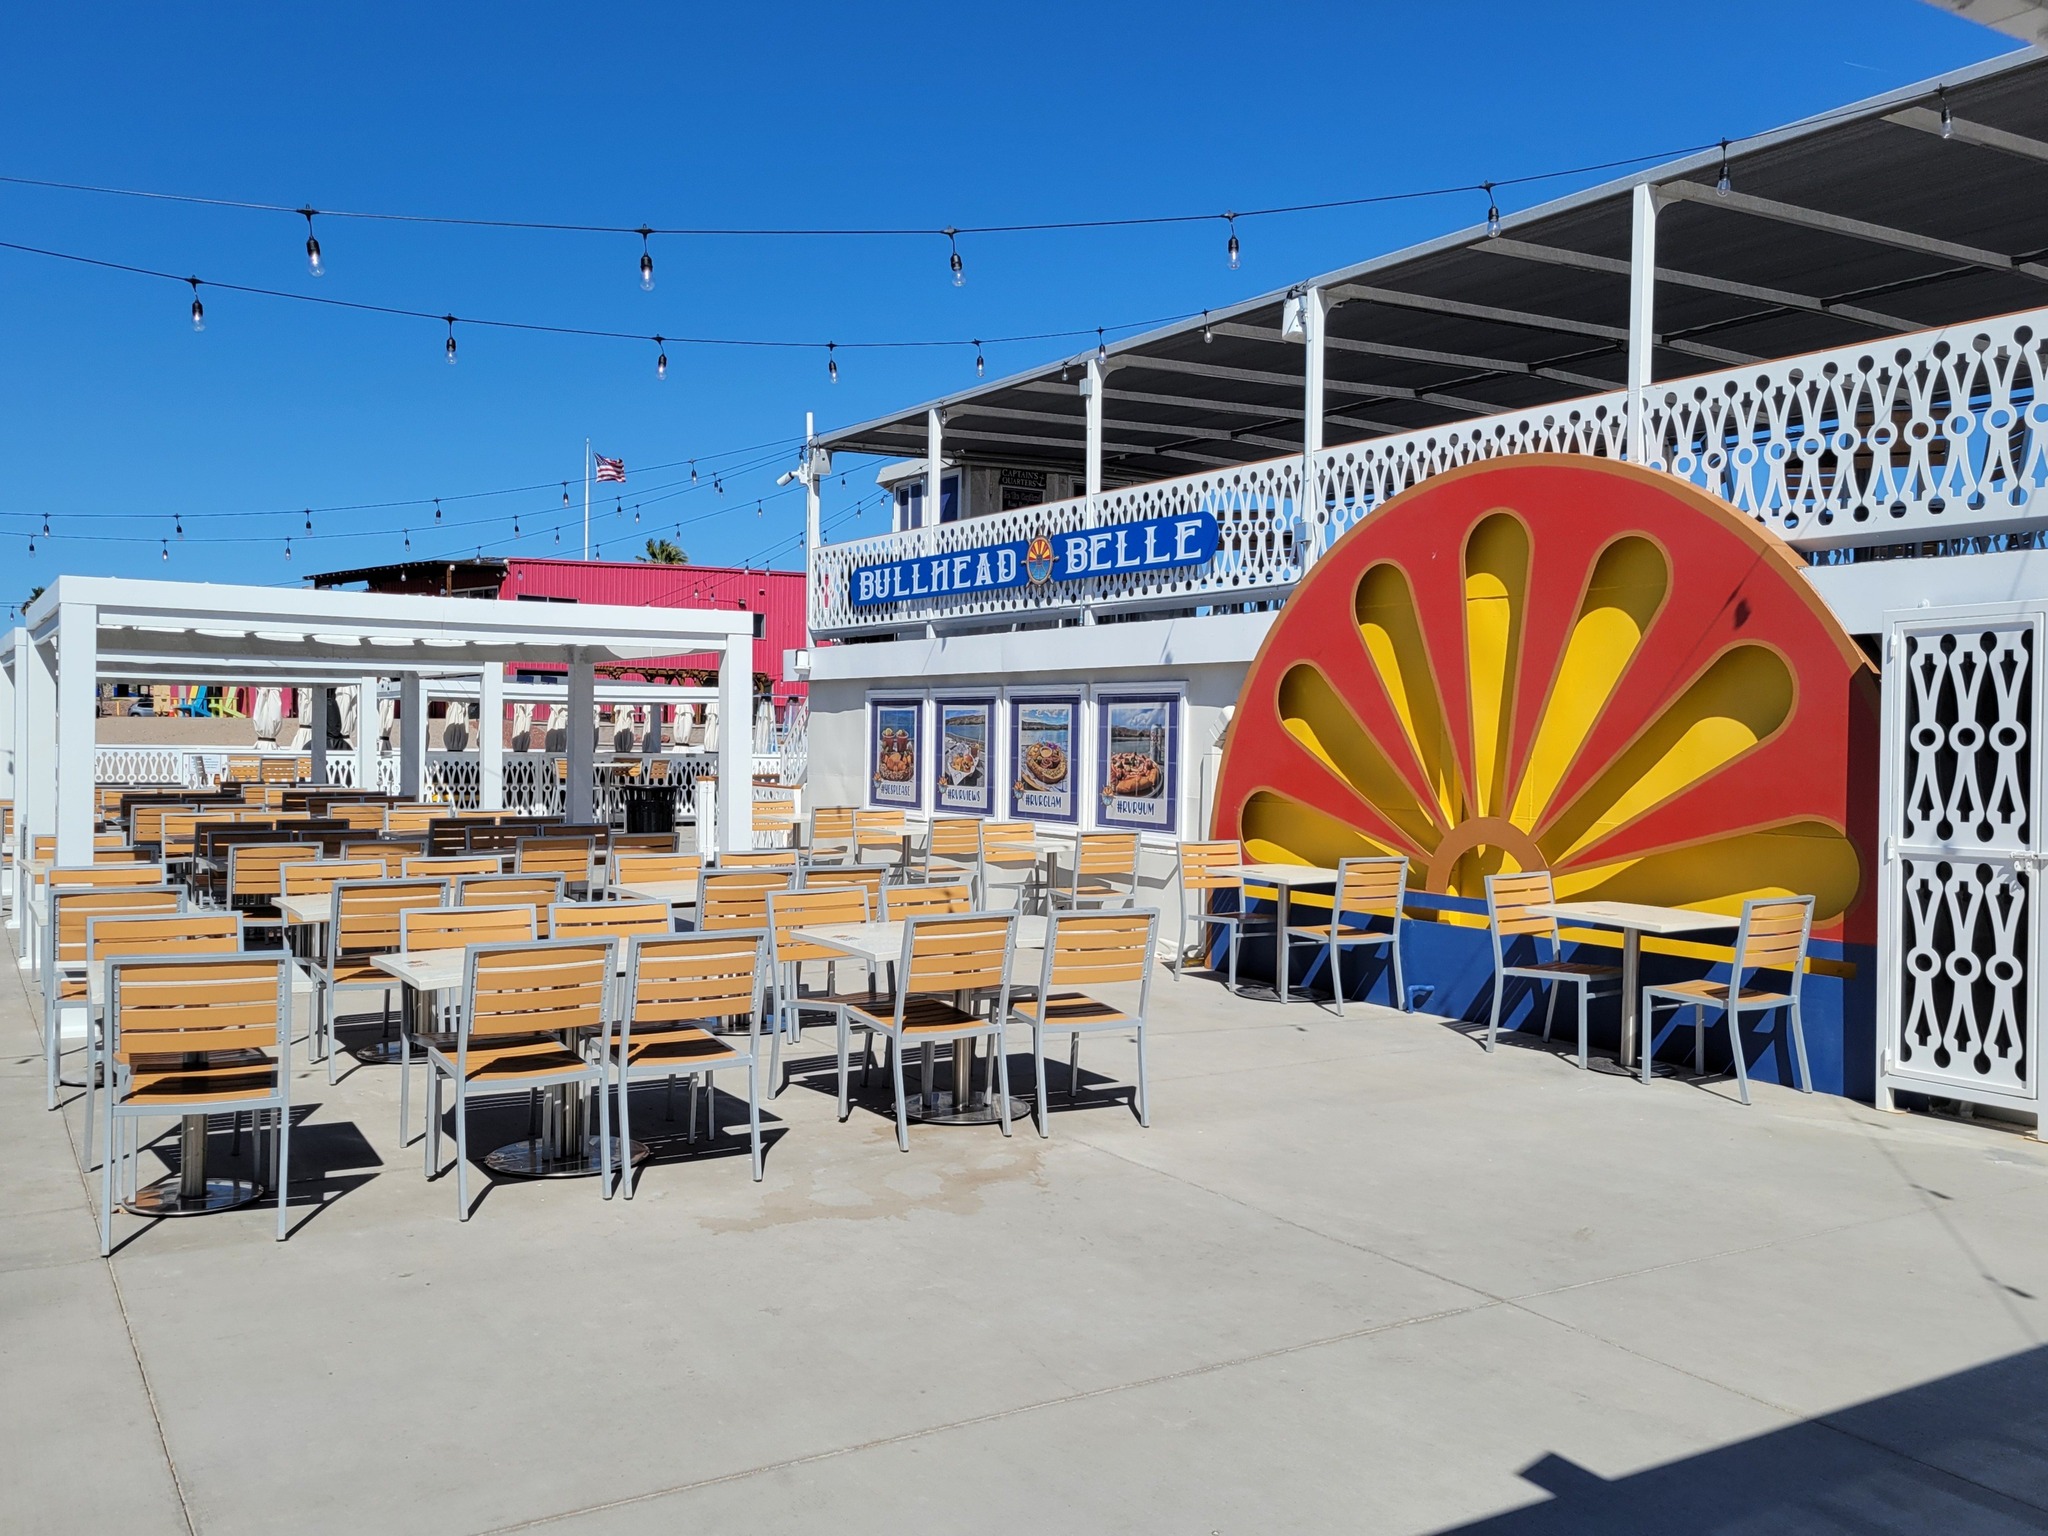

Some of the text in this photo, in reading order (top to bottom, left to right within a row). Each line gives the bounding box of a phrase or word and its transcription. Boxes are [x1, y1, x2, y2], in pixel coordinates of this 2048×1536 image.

[1002, 469, 1038, 479] CAPTAIN'S
[1002, 477, 1036, 487] QUARTERS
[858, 519, 1203, 601] BULLHEAD BELLE
[948, 789, 980, 801] #RVRVIEWS
[1025, 794, 1062, 808] #RVRGLAM
[1117, 801, 1155, 815] #RVRYUM
